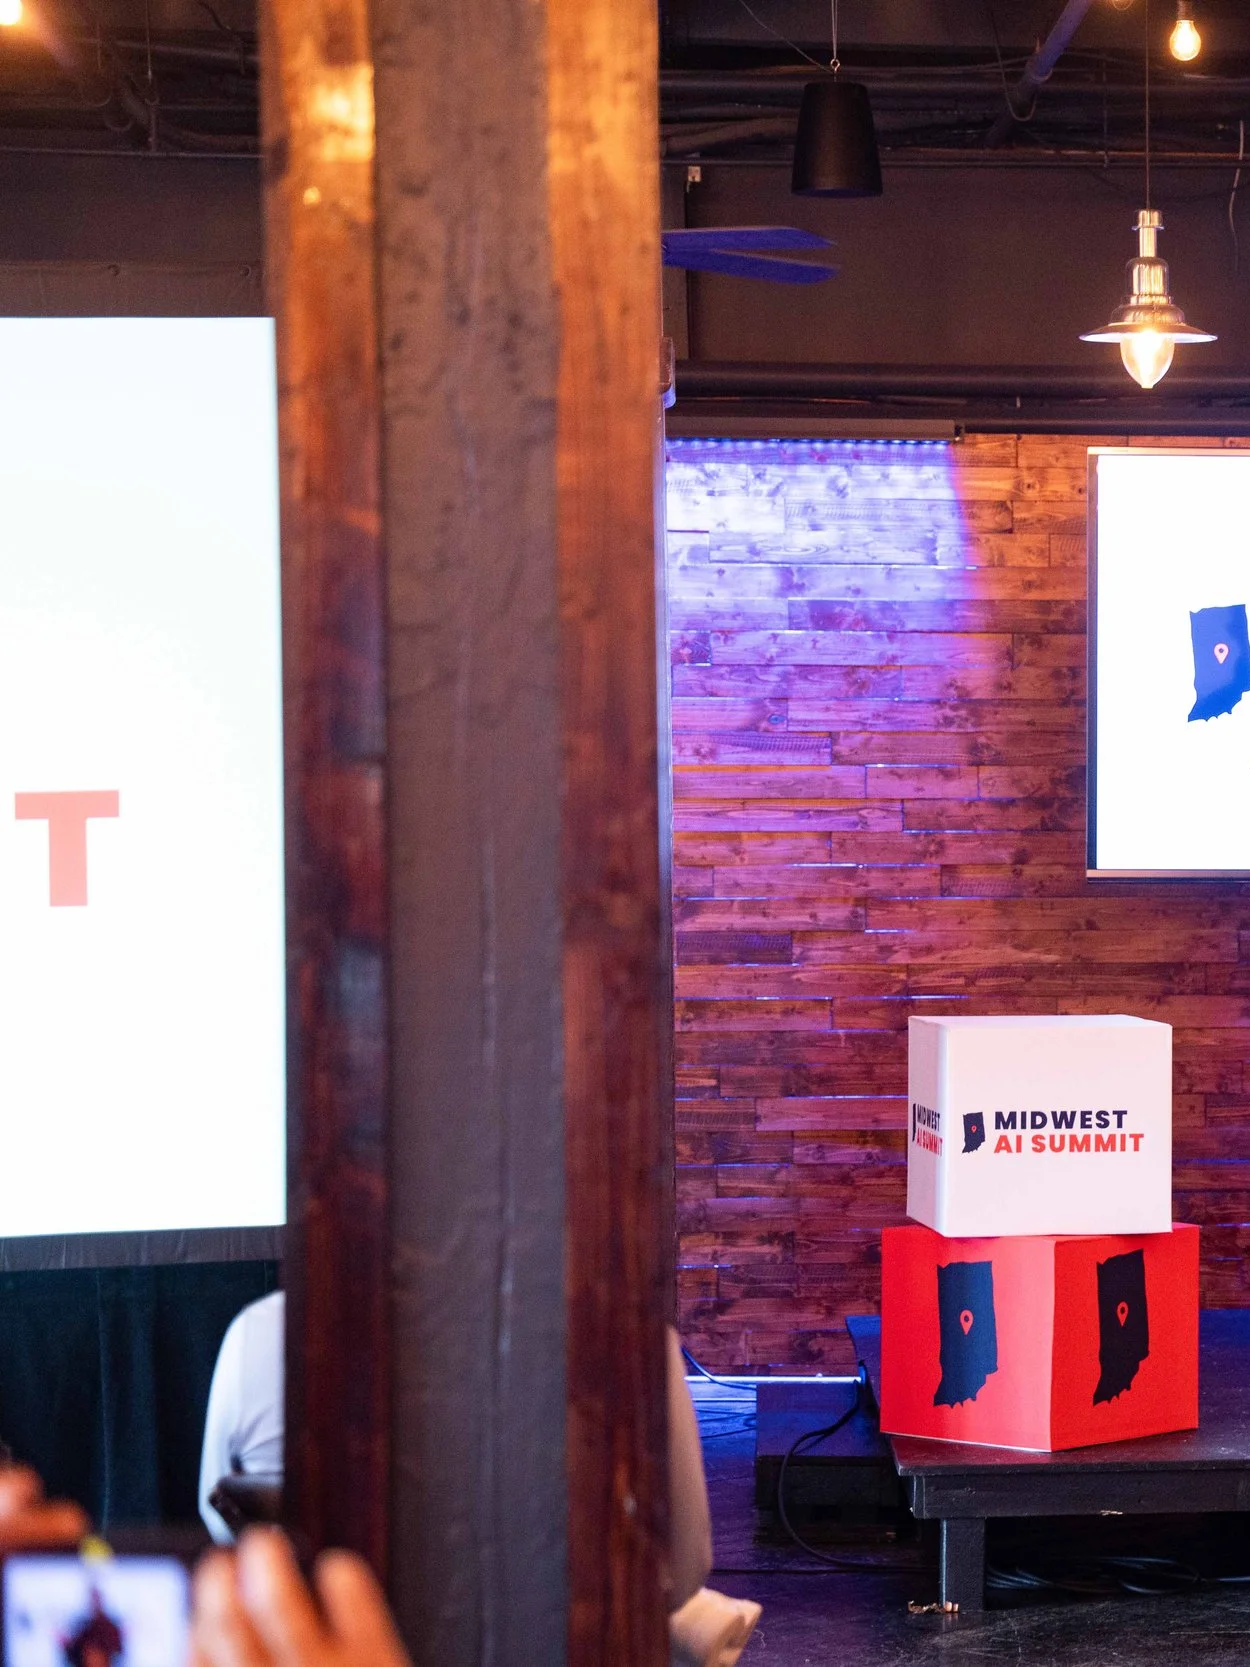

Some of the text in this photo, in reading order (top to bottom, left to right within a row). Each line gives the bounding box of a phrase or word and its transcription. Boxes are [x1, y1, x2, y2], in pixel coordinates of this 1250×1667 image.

[917, 1104, 940, 1131] MIDWEST
[994, 1110, 1128, 1129] MIDWEST
[923, 1130, 942, 1156] SUMMIT
[993, 1133, 1144, 1154] AI SUMMIT
